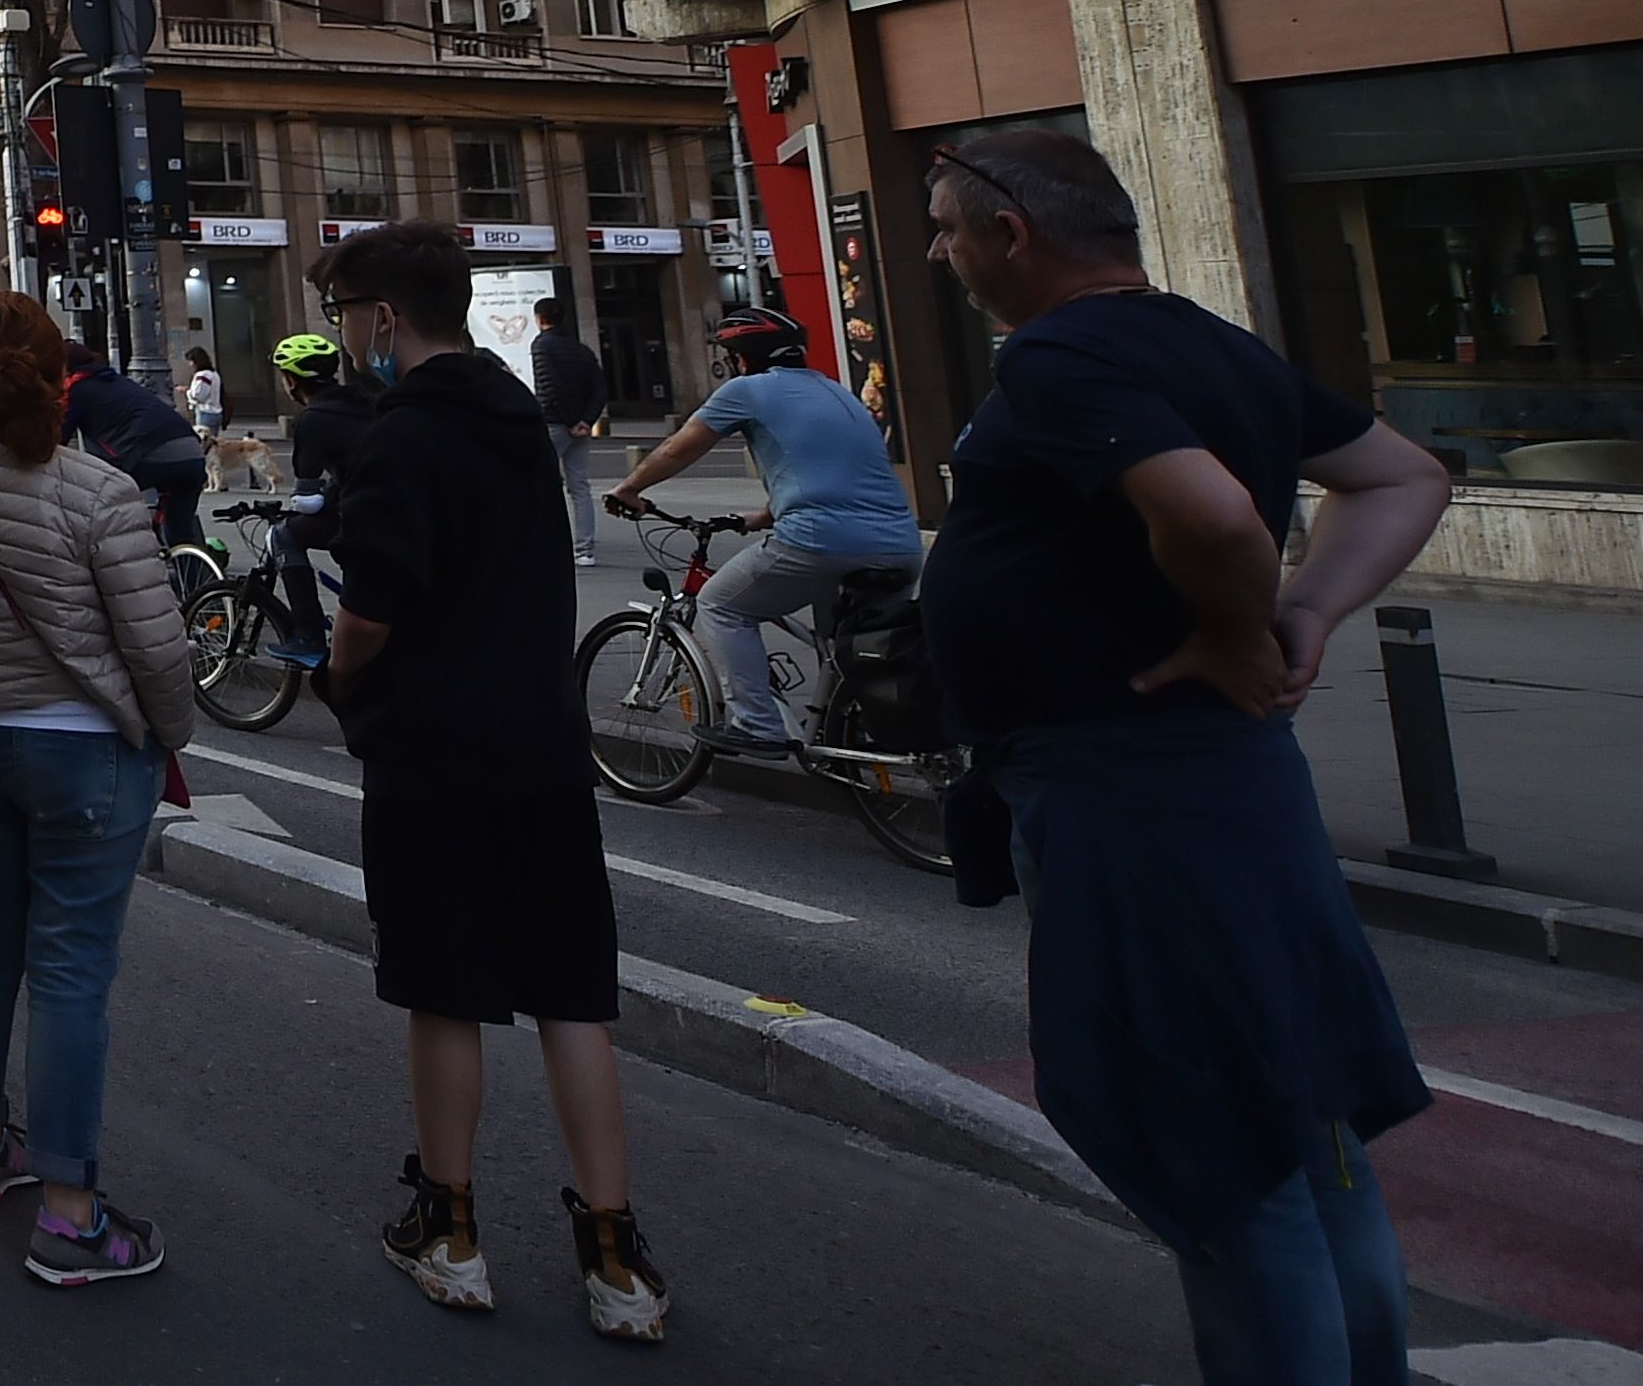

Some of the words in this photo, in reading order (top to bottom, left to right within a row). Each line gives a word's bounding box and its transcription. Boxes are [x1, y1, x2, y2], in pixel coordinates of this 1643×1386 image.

[213, 225, 251, 237] BRD
[484, 231, 520, 244] BRD
[614, 234, 649, 246] BRD
